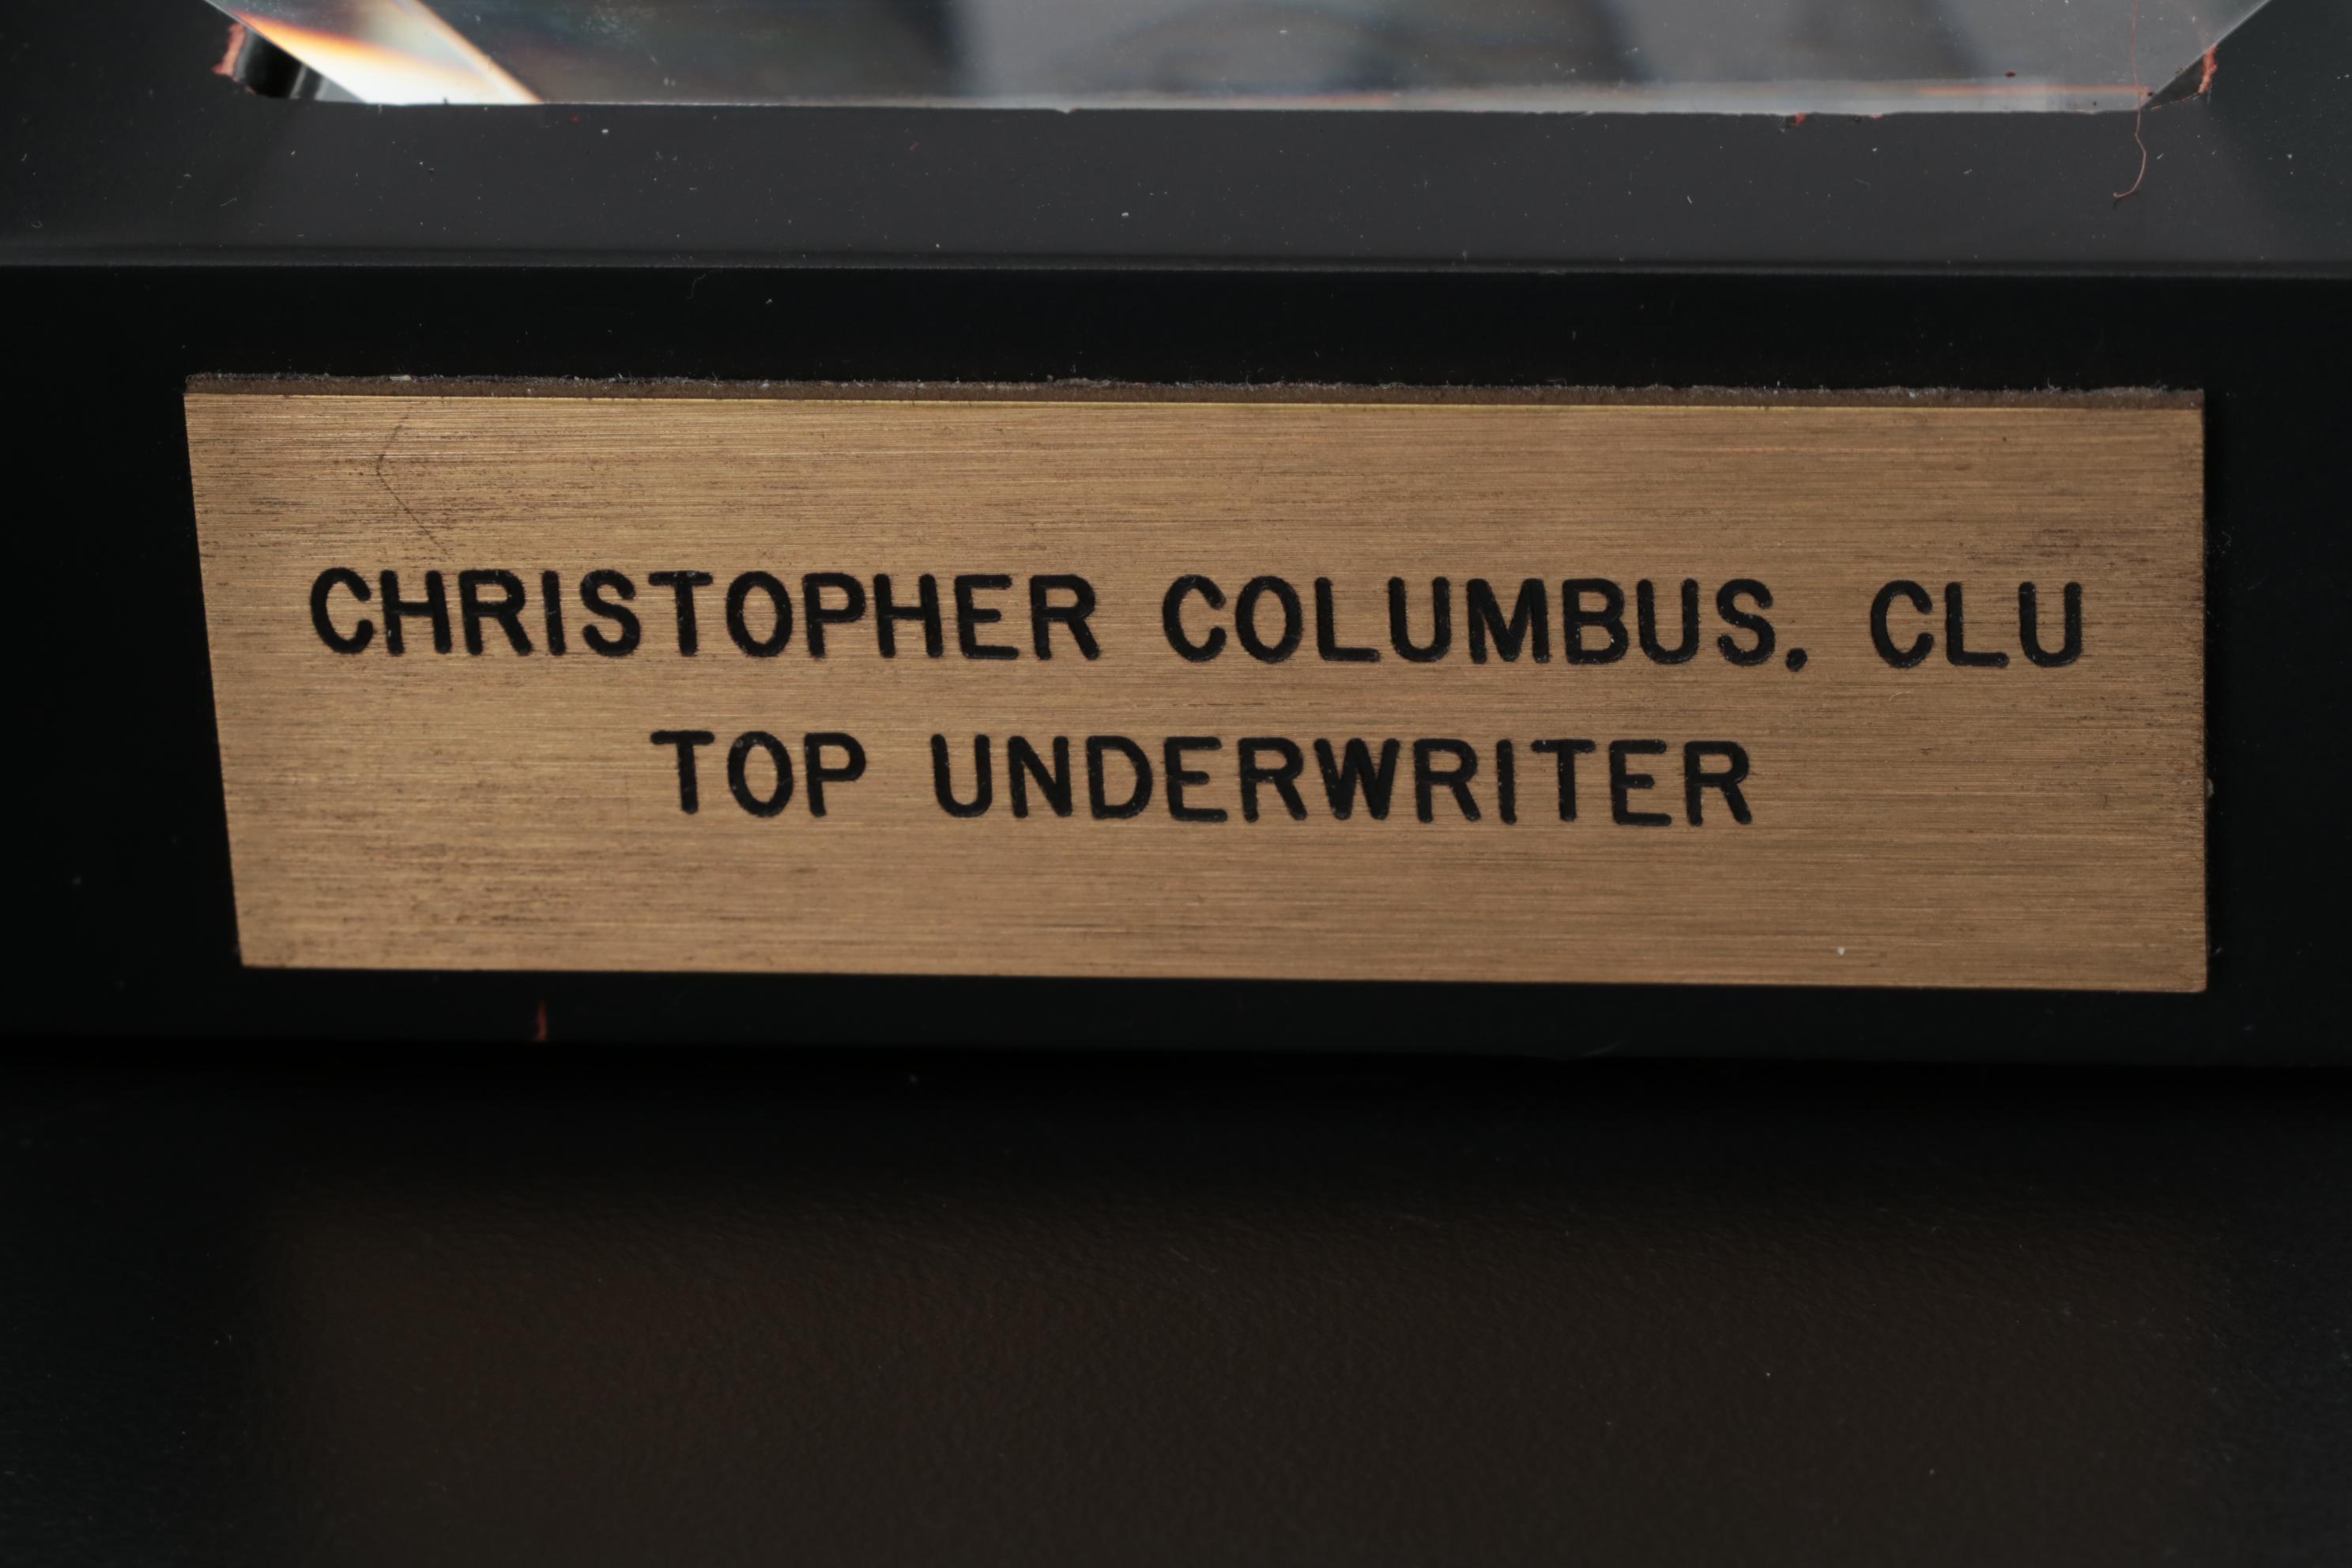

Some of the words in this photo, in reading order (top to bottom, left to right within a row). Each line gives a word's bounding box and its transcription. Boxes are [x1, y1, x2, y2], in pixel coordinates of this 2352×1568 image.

[309, 567, 1102, 662] CHRISTOPHER
[1869, 579, 2093, 671] CLU
[650, 729, 868, 819] TOP
[929, 733, 1753, 827] UNDERWRITER
